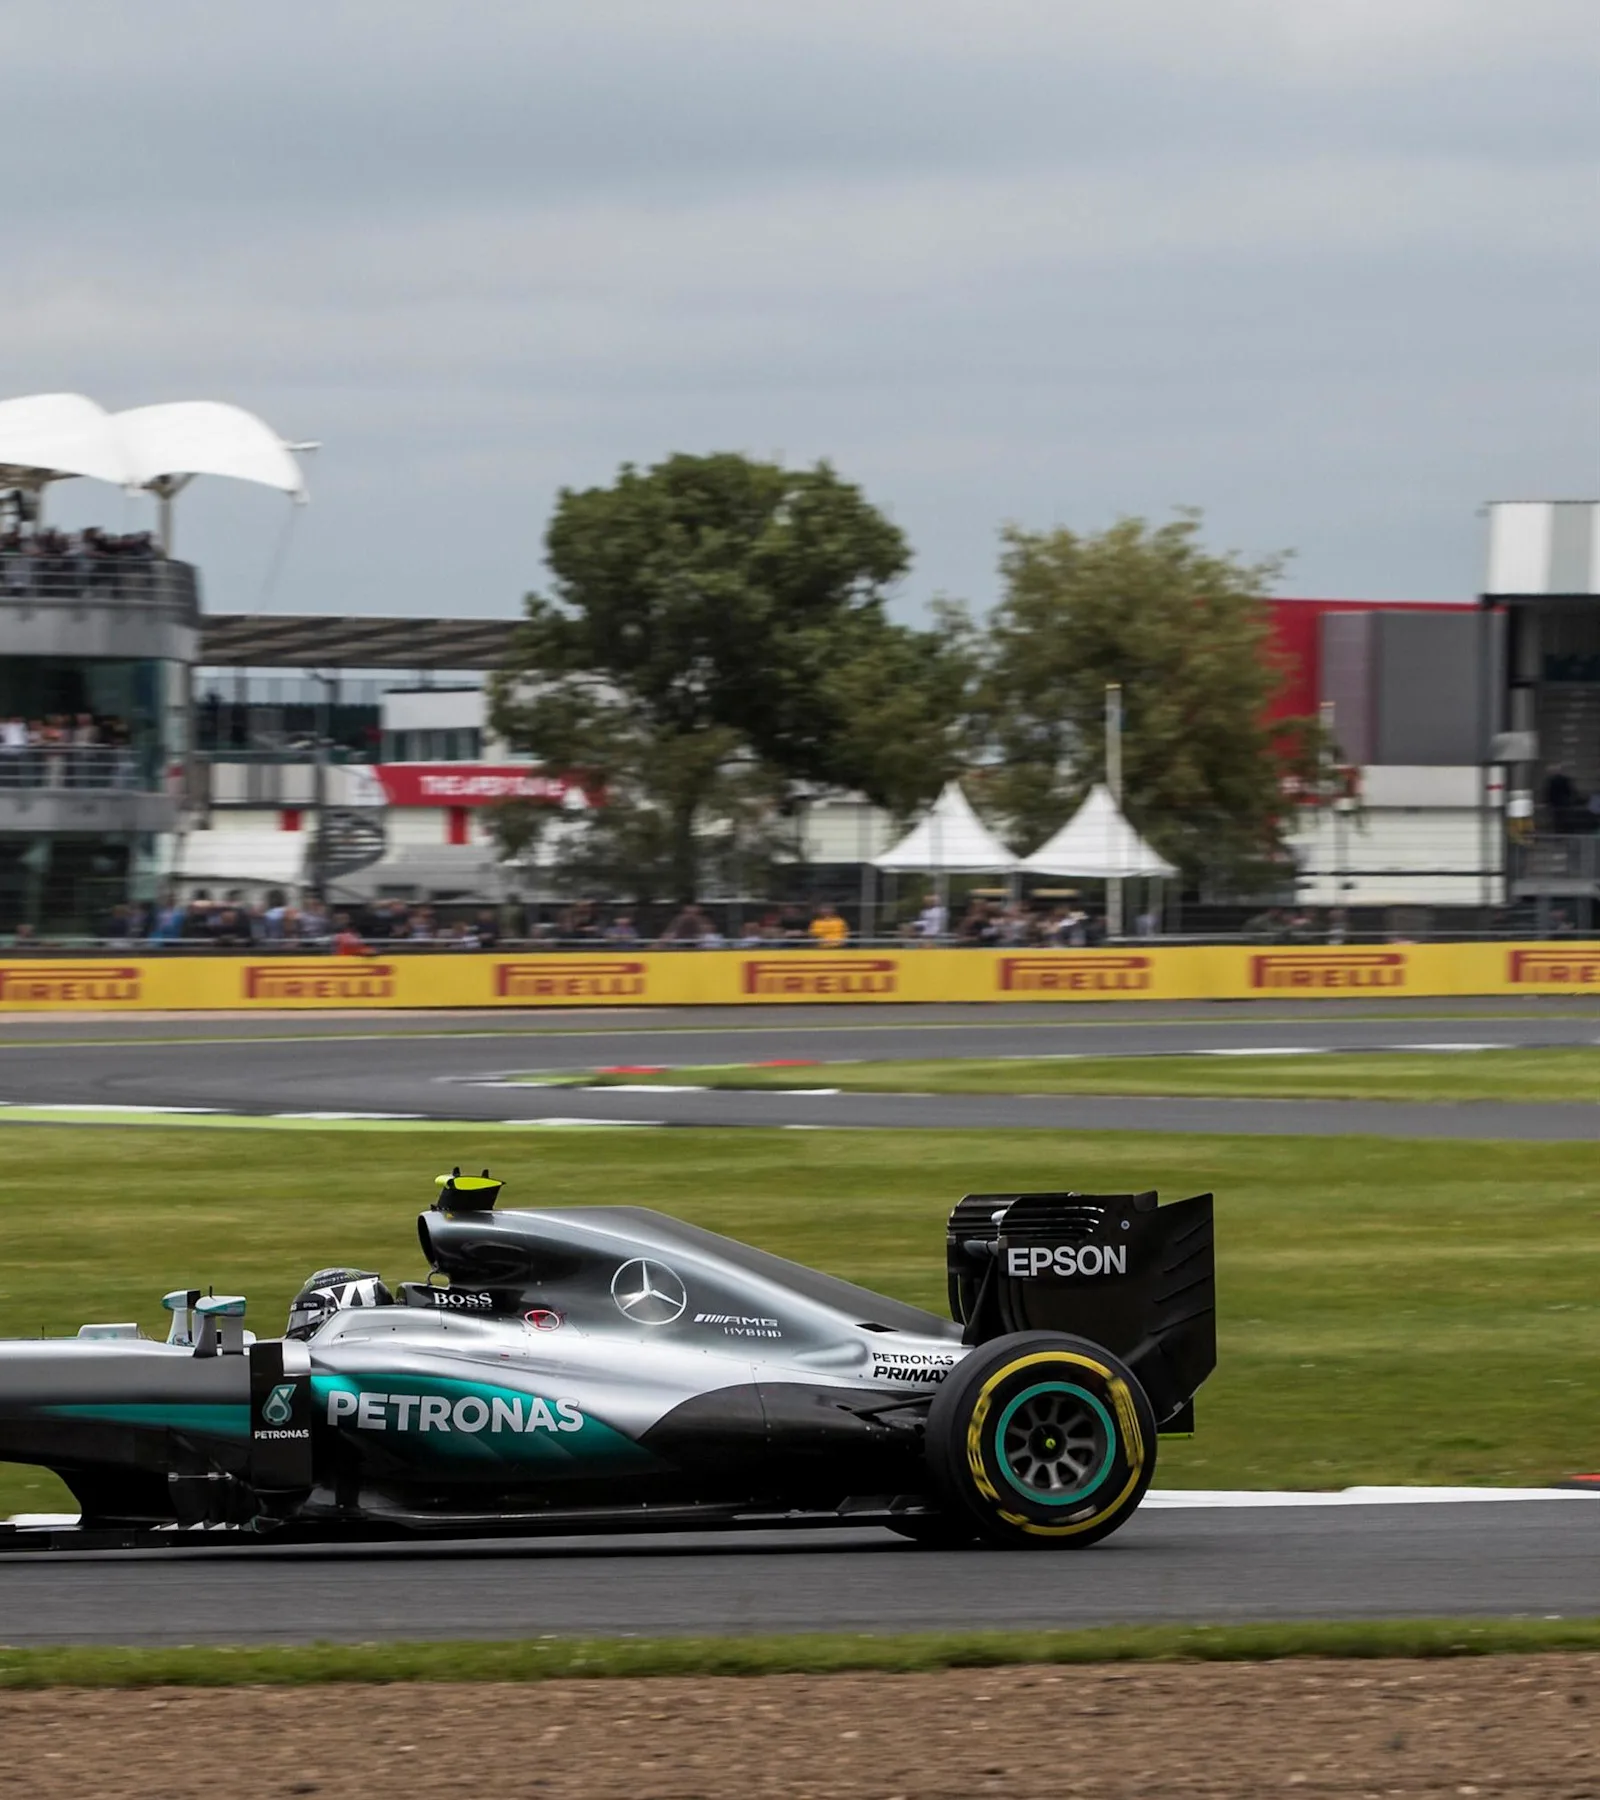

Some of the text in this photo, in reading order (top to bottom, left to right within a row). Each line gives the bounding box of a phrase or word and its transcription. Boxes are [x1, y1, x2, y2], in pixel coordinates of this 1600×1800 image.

[244, 965, 393, 998] PIRELLI
[496, 962, 647, 995] PIRELLI
[744, 959, 896, 993] PIRELLI
[1000, 957, 1152, 990] PIRELLI
[1251, 954, 1405, 987] PIRELLI
[1007, 1245, 1127, 1276] EPSON
[433, 1292, 493, 1305] BOSS
[723, 1316, 778, 1326] AMG
[724, 1327, 782, 1338] HYBRID
[872, 1352, 954, 1366] PETRONAS
[327, 1390, 584, 1433] PETRONAS
[254, 1429, 309, 1439] PETRONAS
